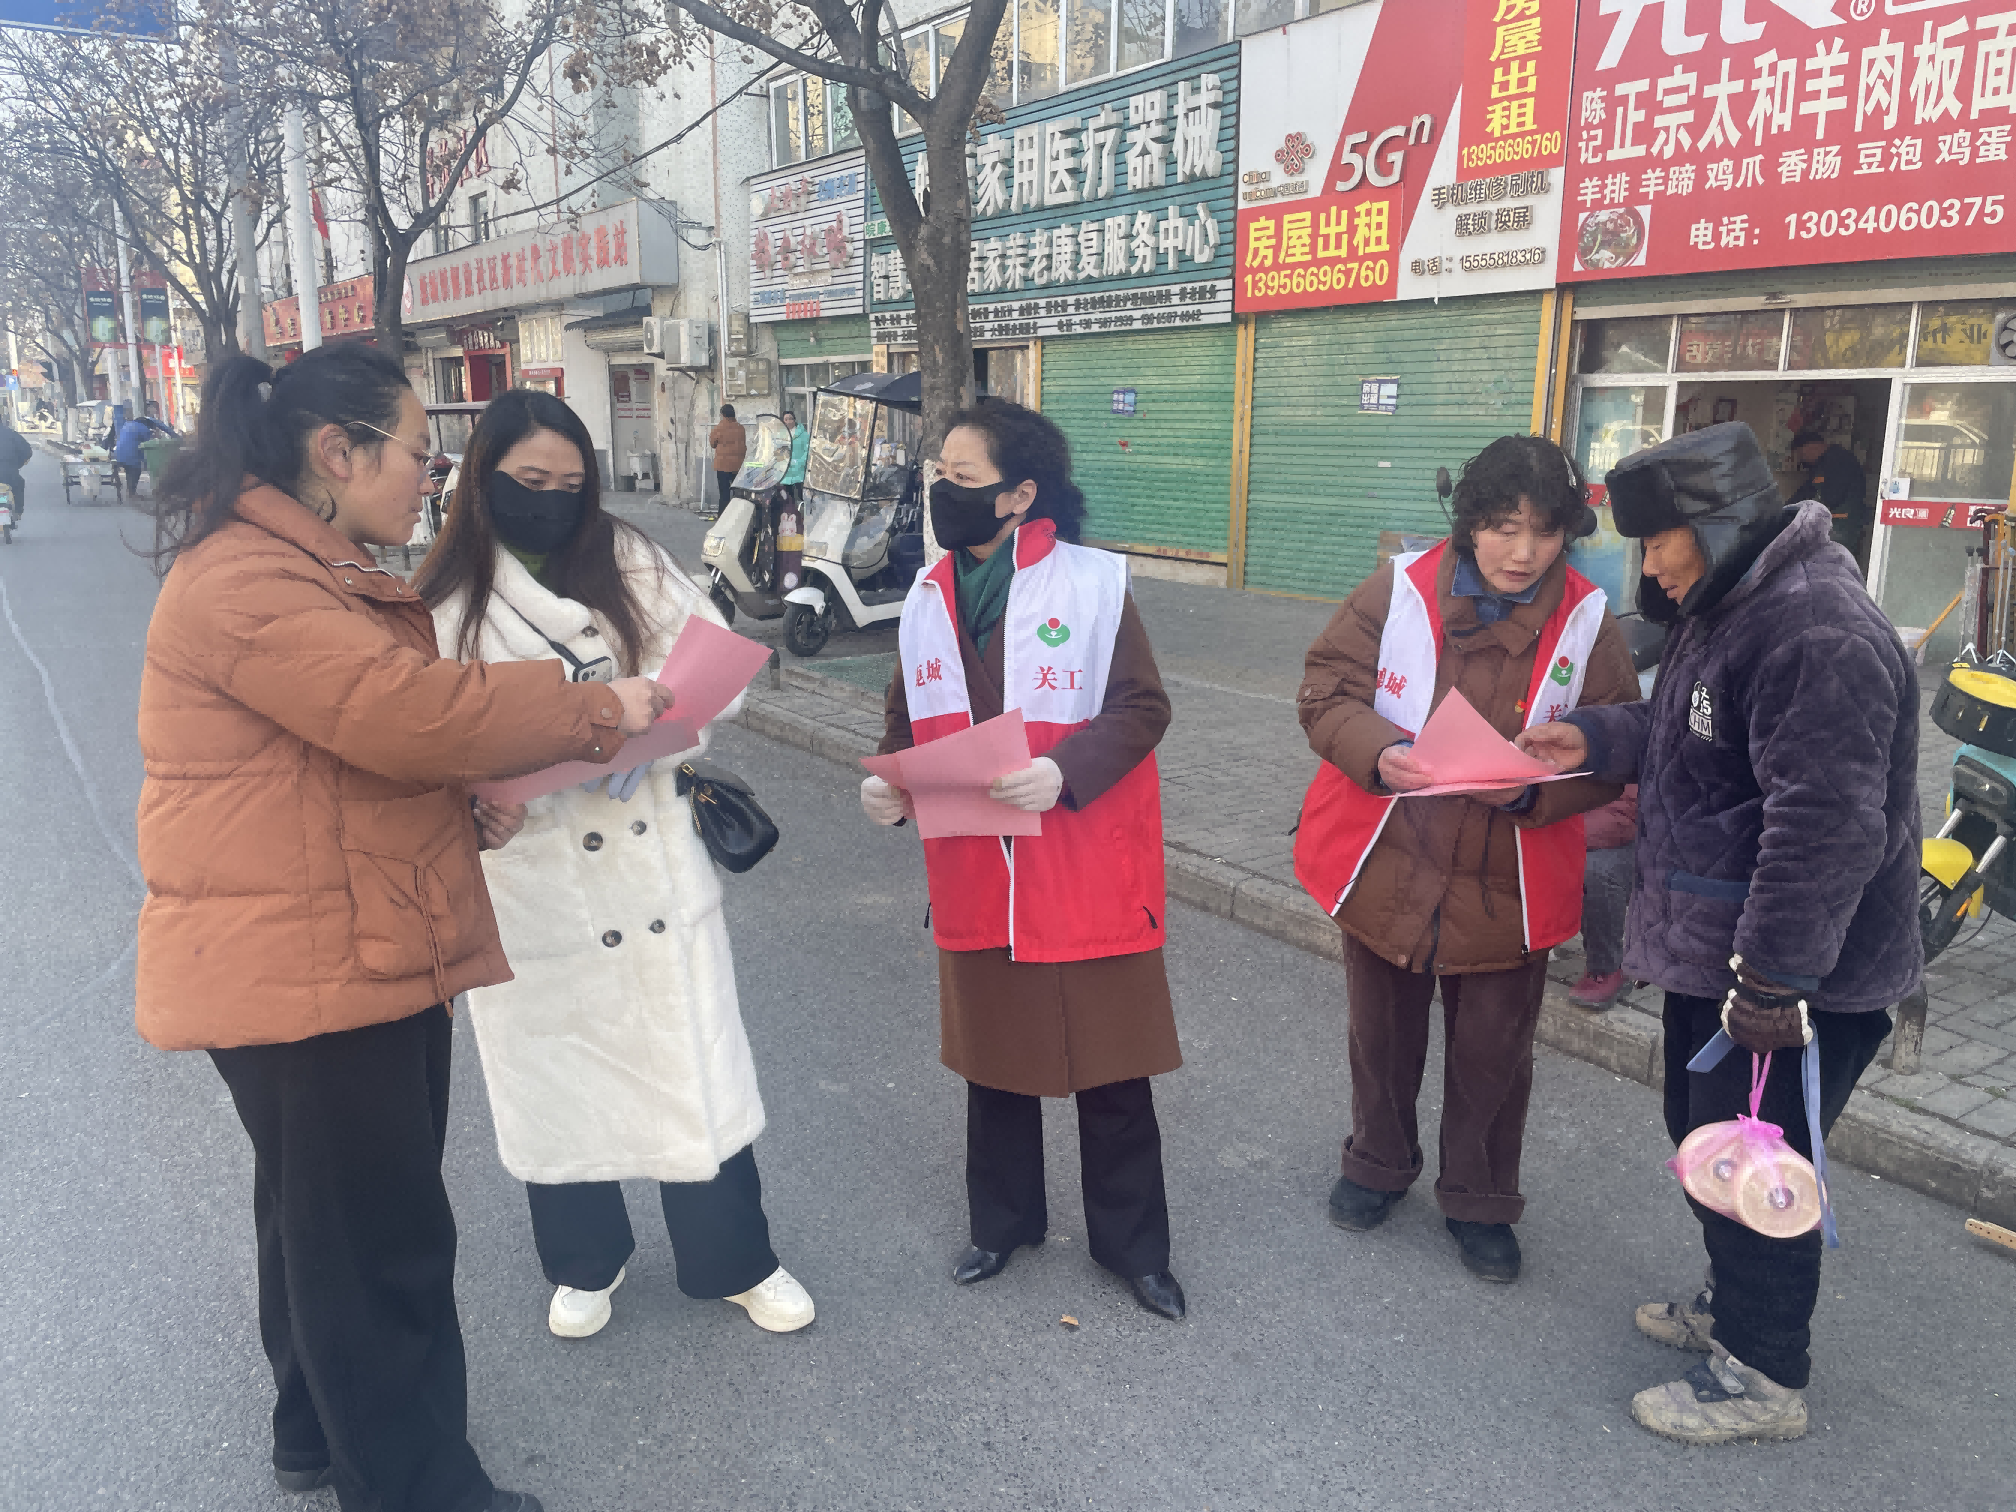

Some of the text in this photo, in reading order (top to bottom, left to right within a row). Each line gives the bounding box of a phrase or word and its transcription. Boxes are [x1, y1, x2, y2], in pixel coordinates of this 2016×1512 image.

[1578, 87, 1607, 166] 陈记
[1461, 131, 1562, 169] 13956696760
[1577, 124, 2013, 208] 羊排 羊蹄 鸡爪 香肠 豆泡 鸡蛋
[1431, 169, 1550, 210] 手机维修 刷机
[1244, 200, 1391, 268] 房屋出租
[1454, 206, 1532, 237] 解锁 换屏
[1784, 194, 2006, 241] 13034060375
[1243, 258, 1390, 299] 13956696760
[1460, 247, 1546, 272] 15555818316
[1032, 666, 1084, 691] 关工
